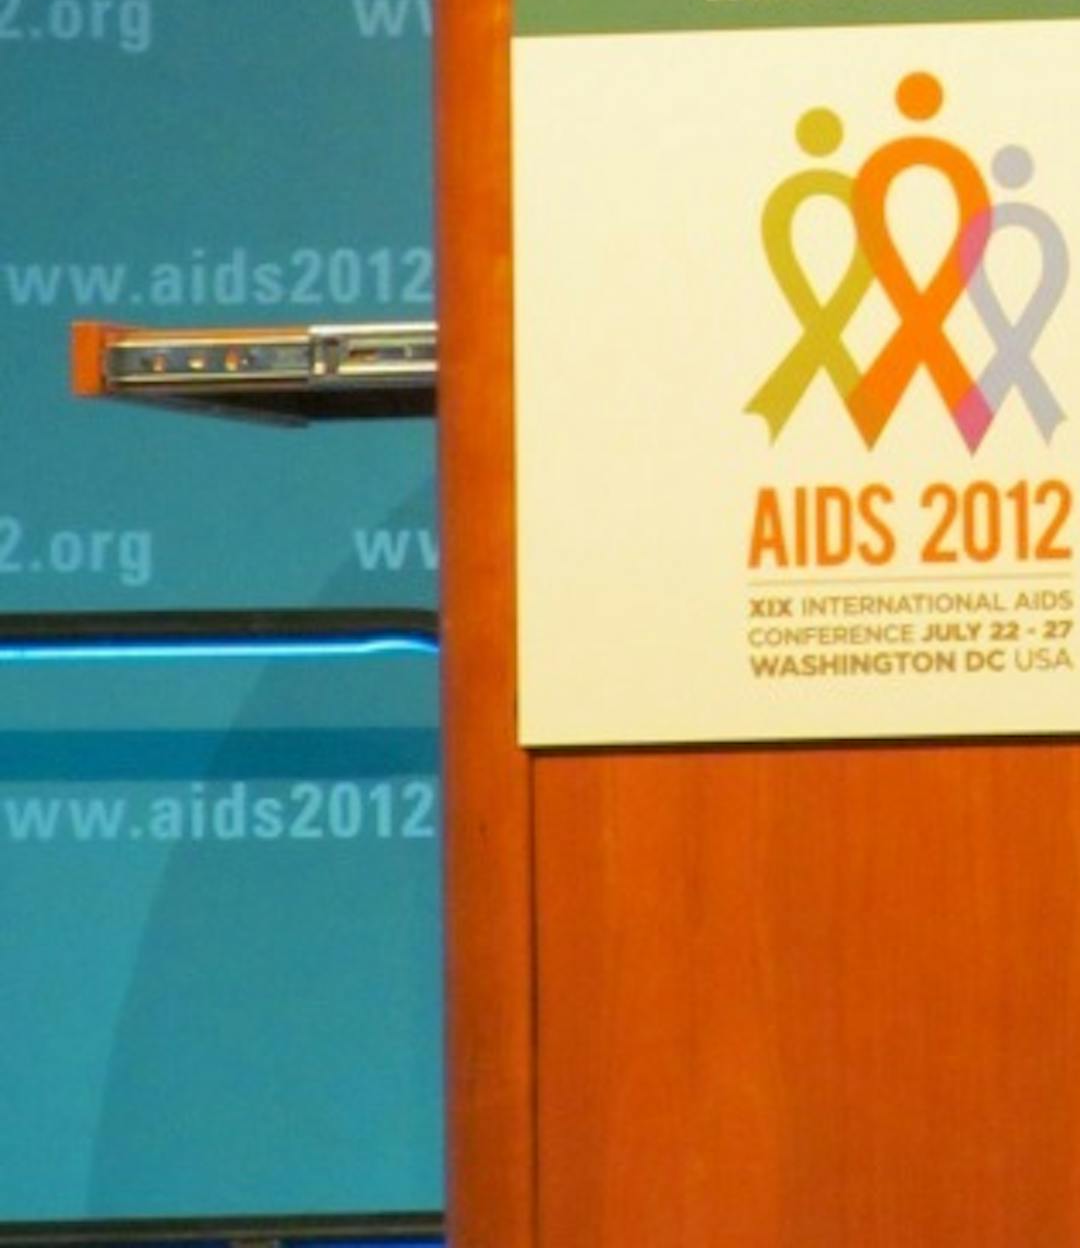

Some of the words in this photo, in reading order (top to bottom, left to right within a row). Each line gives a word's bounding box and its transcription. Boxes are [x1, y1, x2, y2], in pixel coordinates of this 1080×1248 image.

[747, 483, 895, 569] AIDS
[919, 479, 1074, 563] 2012
[750, 598, 793, 618] XIX
[801, 593, 1007, 616] INTERNATIONAL
[1014, 589, 1074, 611] AIDS
[748, 623, 914, 648] CONFERENCE
[920, 622, 982, 643] JULY
[989, 621, 1020, 641] 22
[1044, 619, 1075, 640] 27
[749, 651, 957, 678] WASHINGTON
[965, 650, 1006, 673] DC
[1013, 646, 1074, 673] USA
